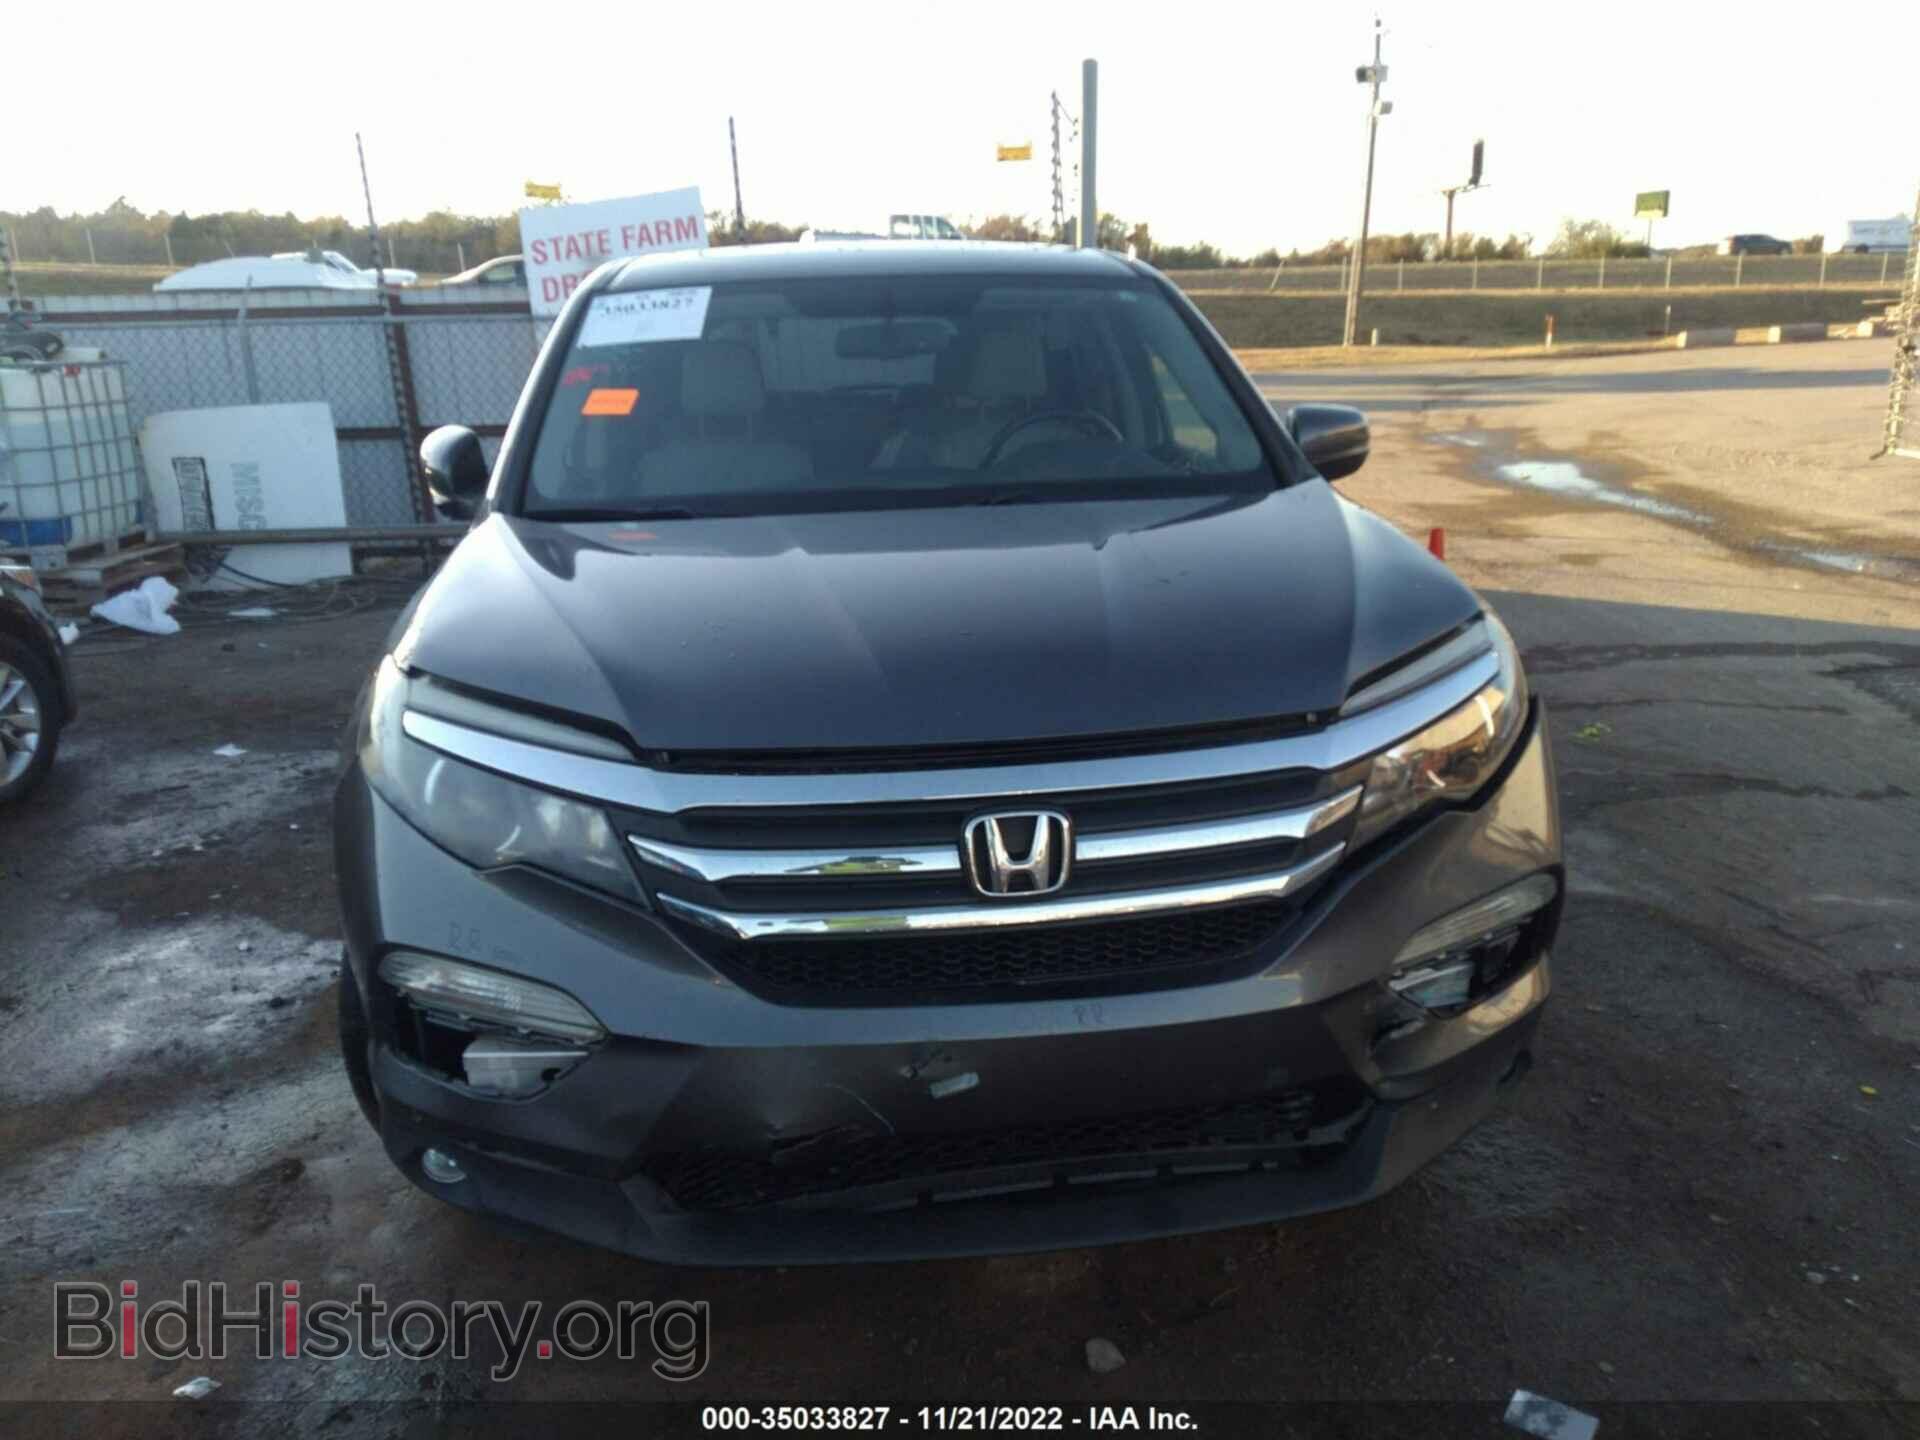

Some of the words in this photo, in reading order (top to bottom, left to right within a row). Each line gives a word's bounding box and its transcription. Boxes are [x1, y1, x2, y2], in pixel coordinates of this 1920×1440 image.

[530, 229, 612, 265] STATE
[620, 214, 699, 250] FARM
[541, 269, 593, 302] DR
